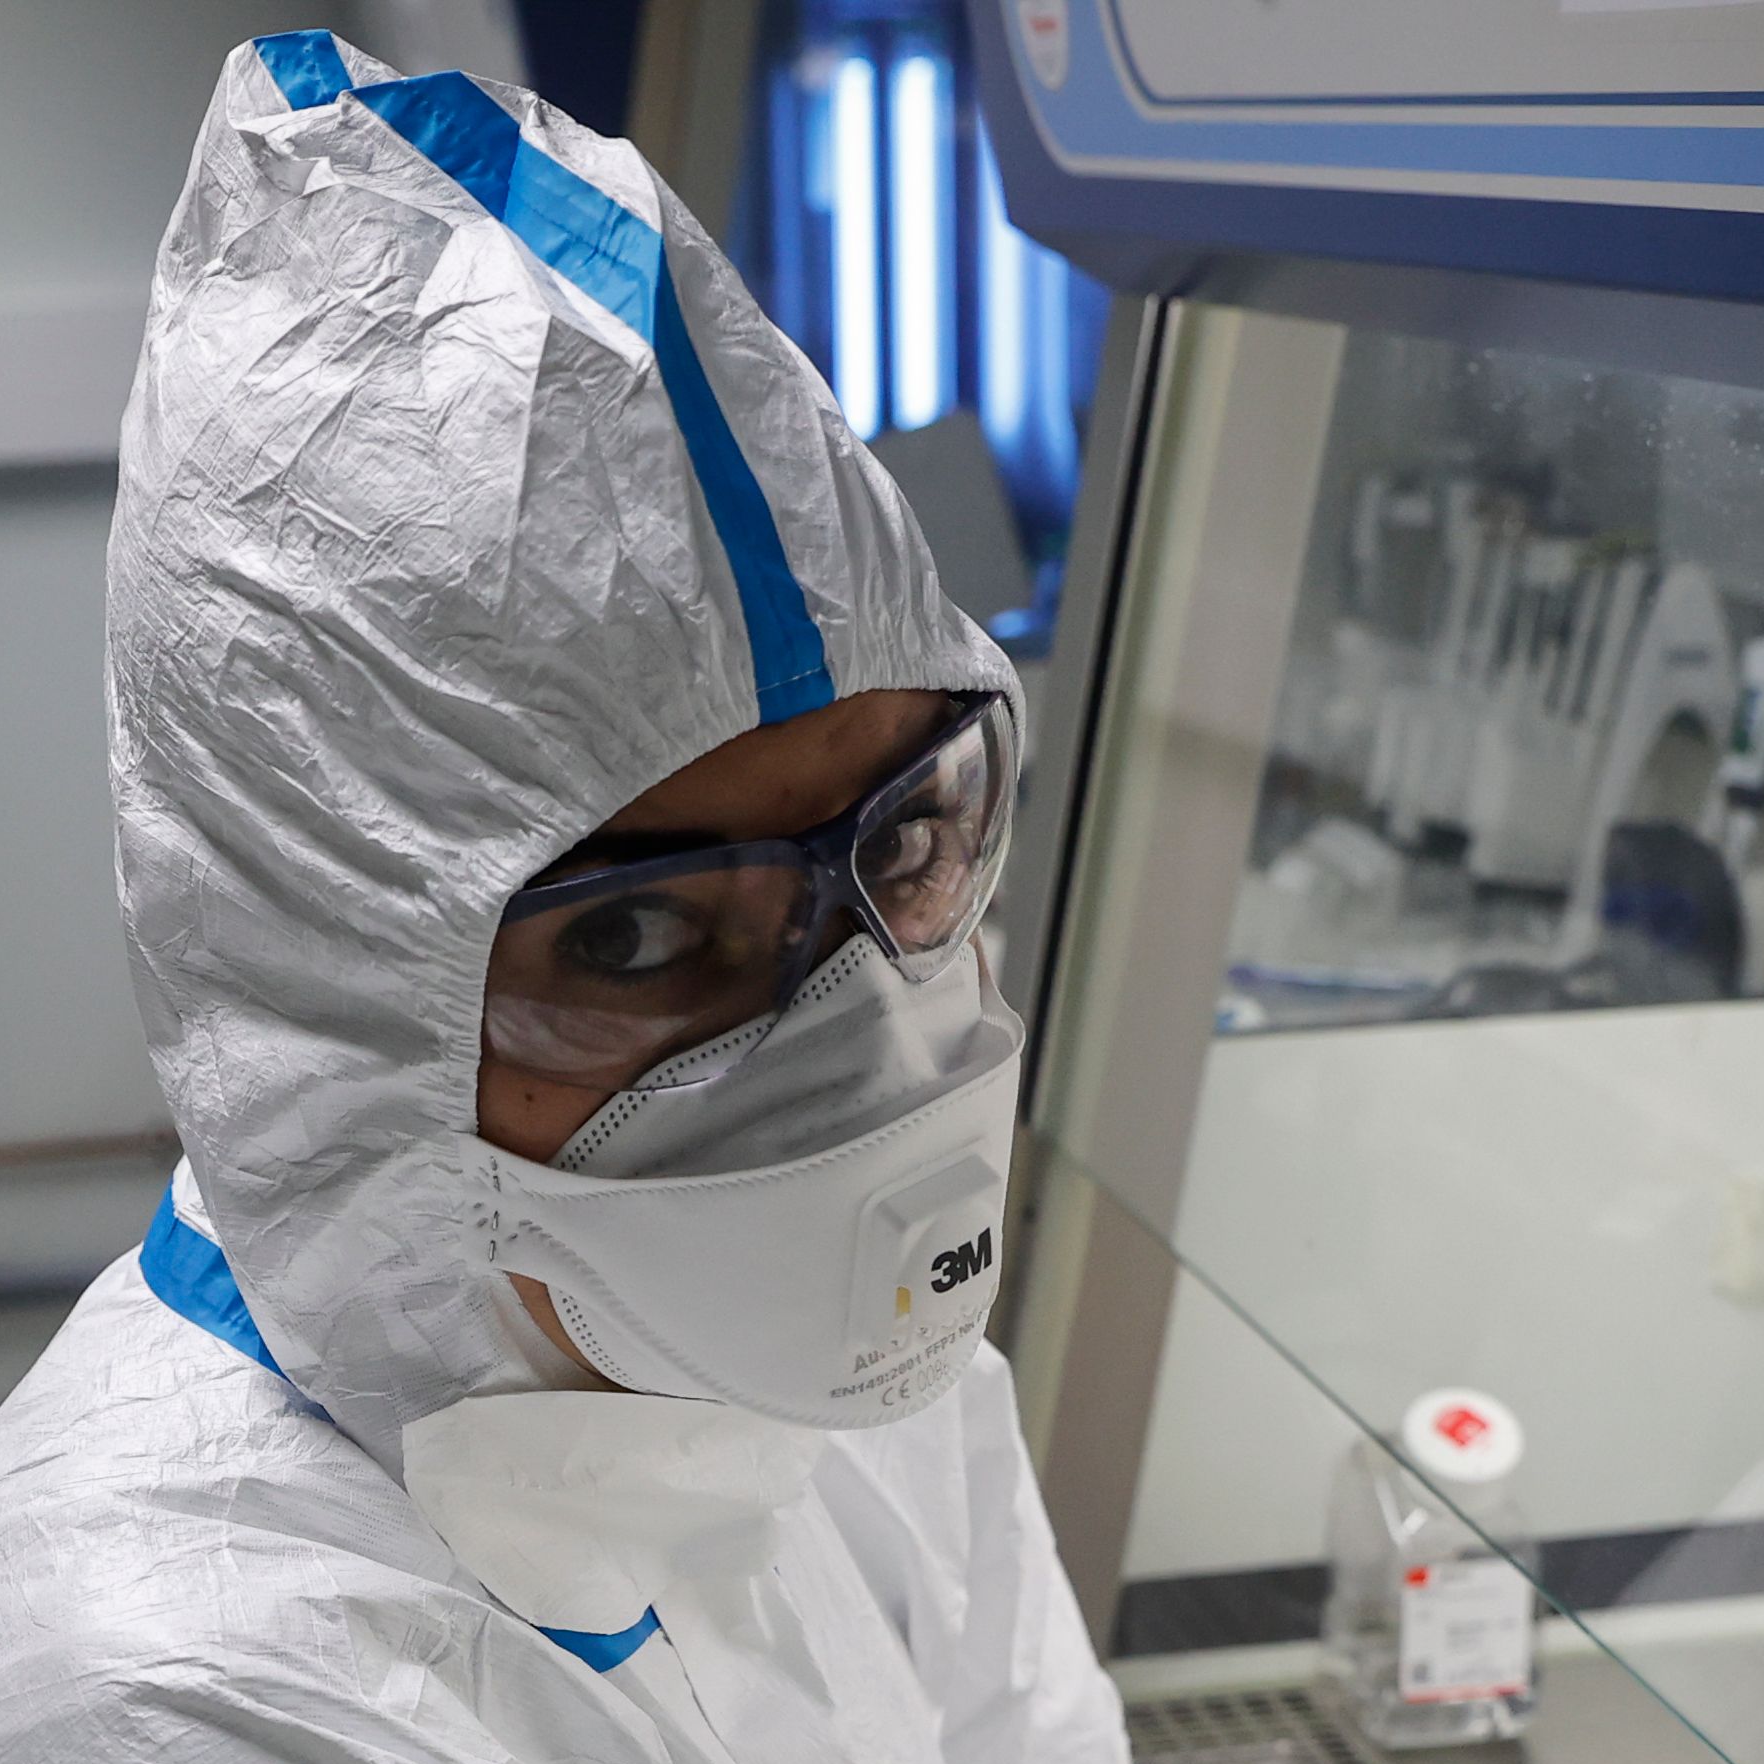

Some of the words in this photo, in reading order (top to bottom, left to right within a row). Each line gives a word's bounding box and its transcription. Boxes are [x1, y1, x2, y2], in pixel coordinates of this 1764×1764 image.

[930, 1226, 993, 1294] 3M
[829, 1353, 922, 1399] EN149:2001
[925, 1332, 956, 1359] FFP3
